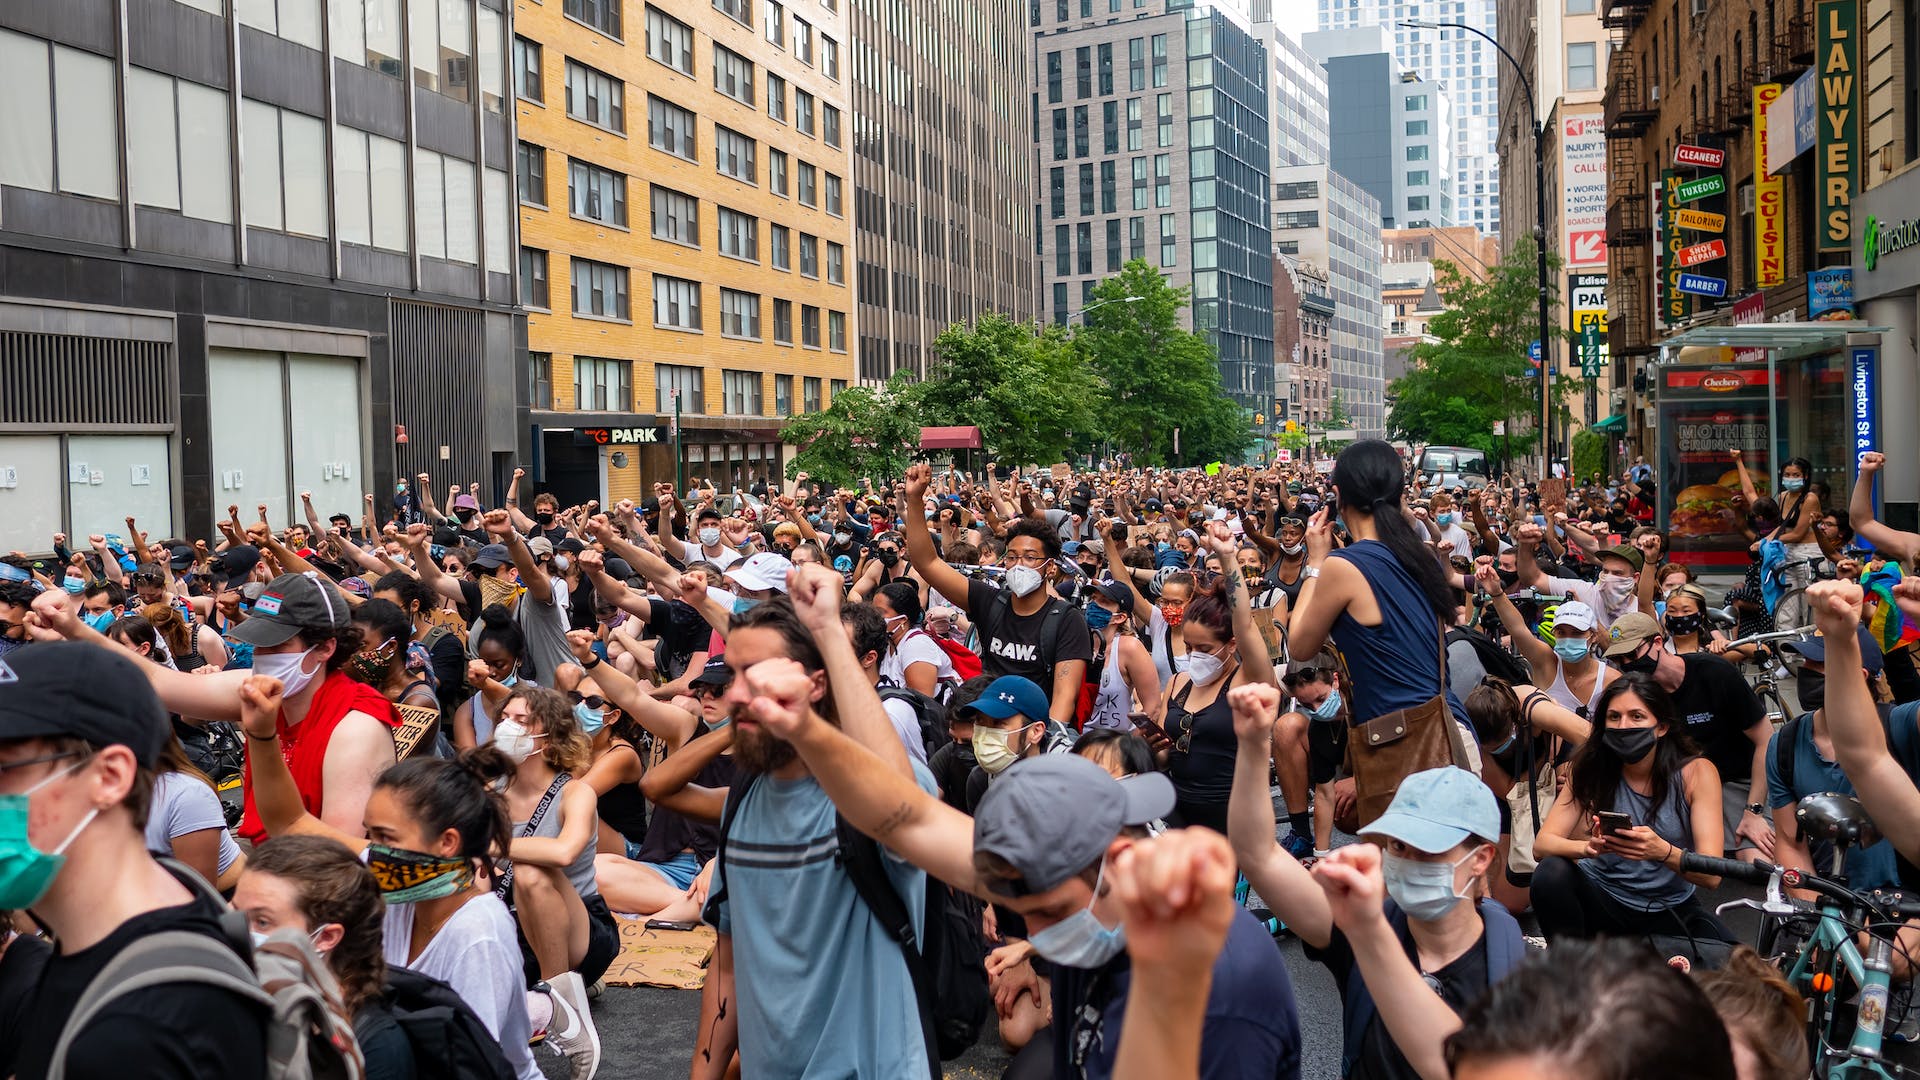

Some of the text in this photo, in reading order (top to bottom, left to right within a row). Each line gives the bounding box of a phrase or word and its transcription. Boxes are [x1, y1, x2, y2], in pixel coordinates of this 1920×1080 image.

[1823, 9, 1852, 241] LAWYERS
[1566, 142, 1597, 152] INJURY
[1679, 149, 1721, 164] CLEANERS
[1574, 163, 1597, 173] CALL
[1681, 180, 1721, 197] TUXEDOS
[1681, 213, 1722, 228] TAILORING
[1760, 191, 1779, 285] CUISINE
[1687, 250, 1718, 264] REPAIR
[1689, 243, 1712, 256] SHOE
[1685, 278, 1719, 293] BARBER
[1815, 273, 1849, 283] POKE
[1585, 325, 1597, 376] PIZZA
[1704, 378, 1740, 387] Checkers
[1854, 354, 1869, 418] Livingston
[611, 428, 658, 443] PARK
[1678, 424, 1768, 440] MOTHER
[1857, 421, 1870, 435] St
[1678, 439, 1768, 451] CRUNCHER
[1858, 439, 1870, 449] &
[990, 637, 1037, 661] RAW.
[530, 796, 552, 826] BAGGU
